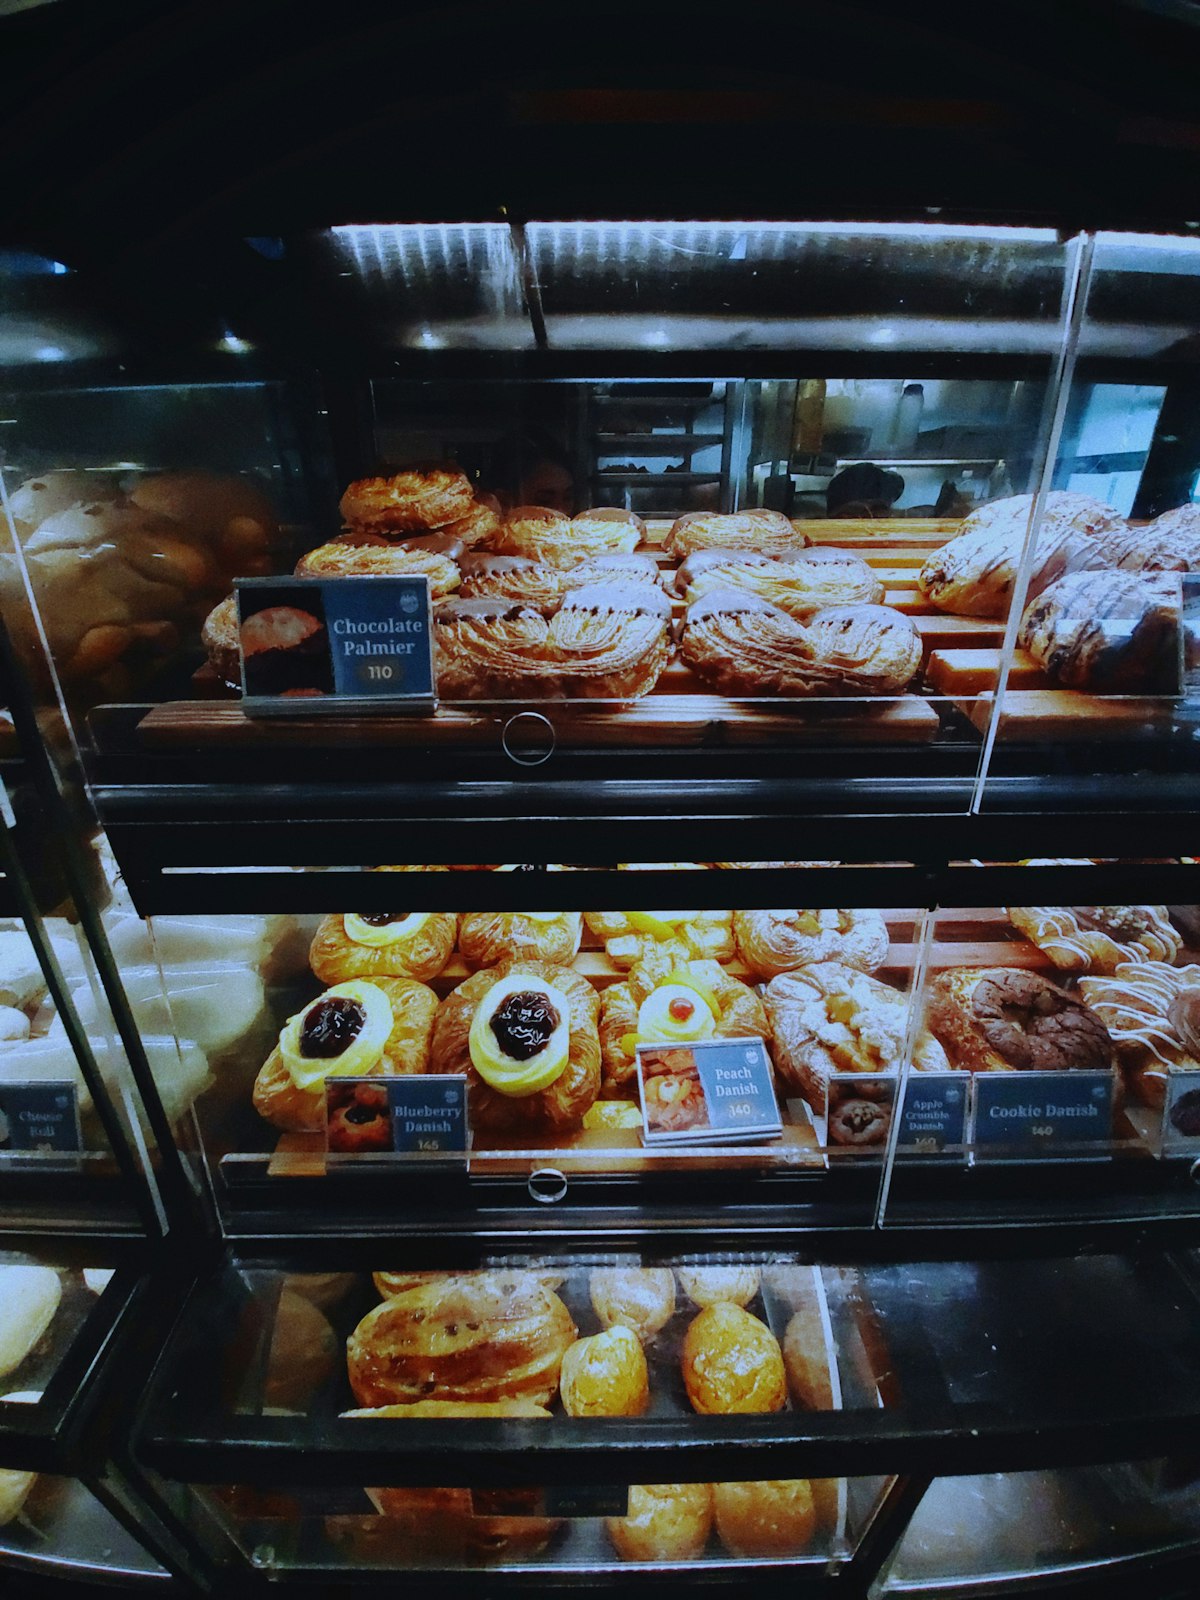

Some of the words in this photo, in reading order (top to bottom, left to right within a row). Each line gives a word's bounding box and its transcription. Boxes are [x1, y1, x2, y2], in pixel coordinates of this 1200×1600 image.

[333, 618, 423, 634] Chocolate
[343, 639, 416, 656] Palmier
[368, 665, 393, 680] 110
[715, 1066, 752, 1080] Peach
[715, 1082, 759, 1097] Danish
[394, 1105, 461, 1119] Blueberry
[729, 1104, 751, 1116] 140
[912, 1100, 943, 1111] Apple
[989, 1105, 1041, 1118] Cookie
[1045, 1104, 1098, 1117] Danish
[905, 1111, 950, 1120] Crumble
[405, 1121, 451, 1132] Danish
[908, 1121, 944, 1131] Danish
